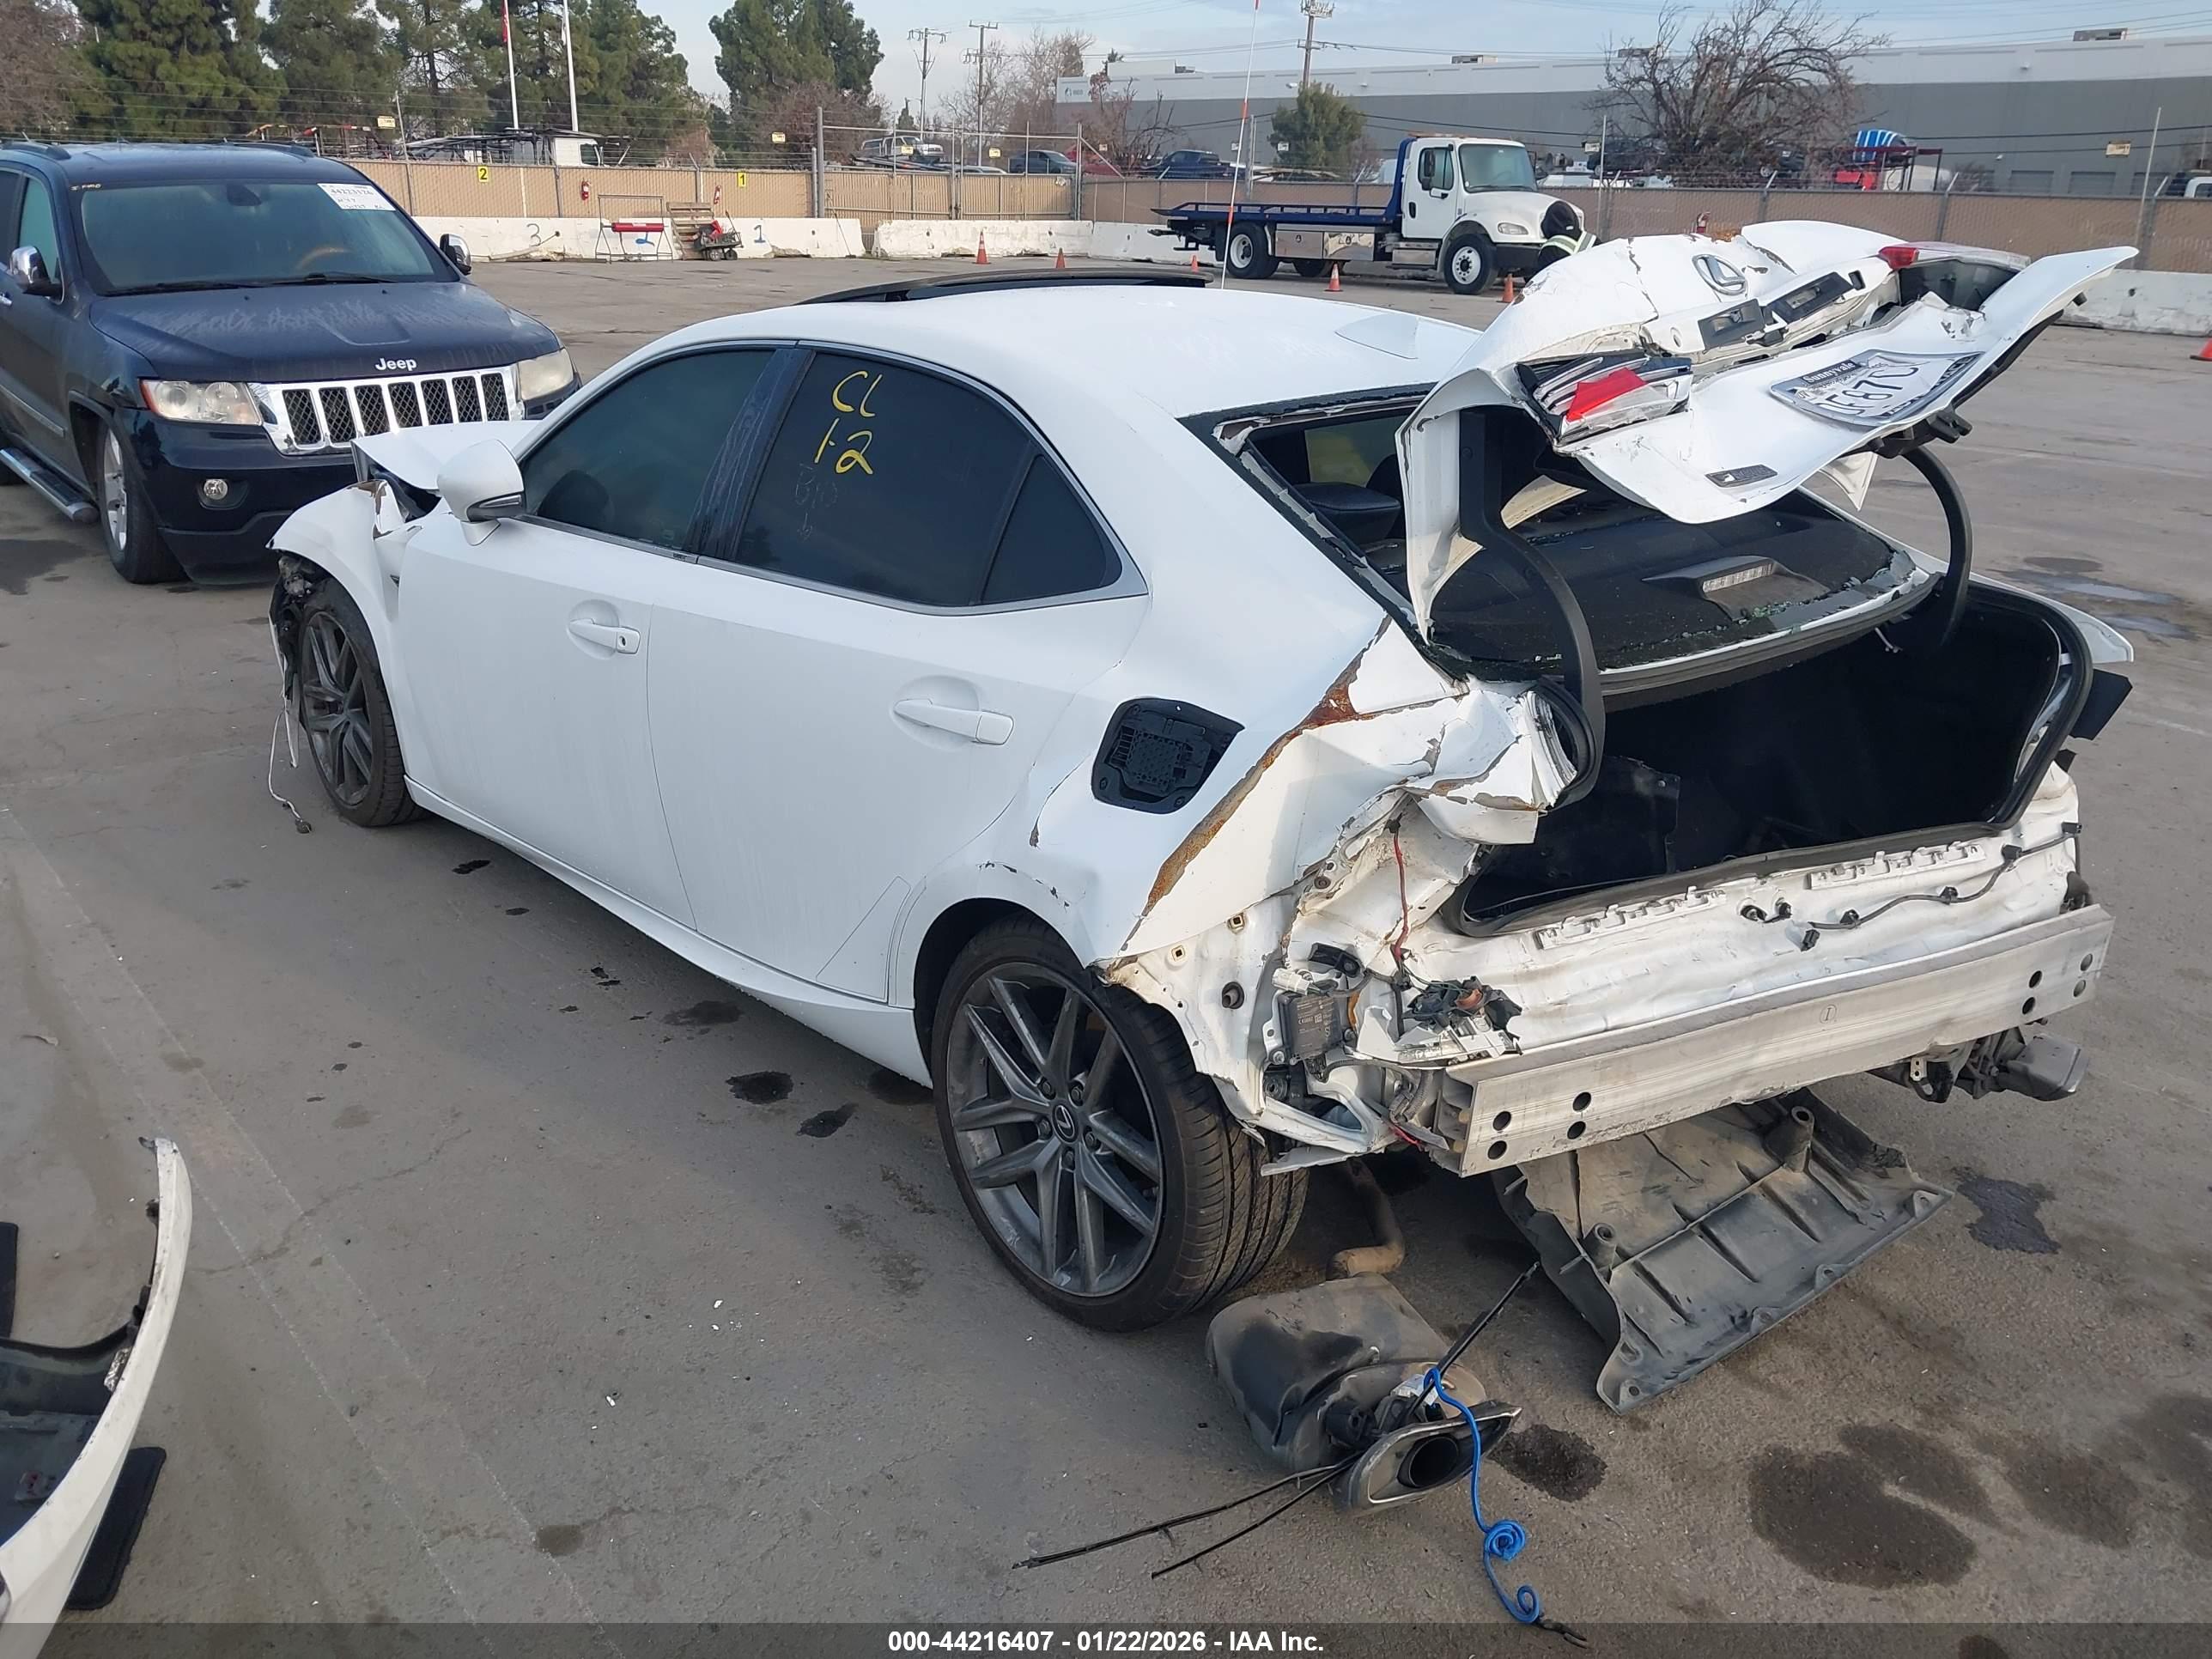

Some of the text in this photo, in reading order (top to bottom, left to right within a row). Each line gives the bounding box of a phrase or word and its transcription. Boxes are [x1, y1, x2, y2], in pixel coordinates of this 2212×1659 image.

[479, 167, 488, 180] 2
[739, 173, 744, 185] 1
[526, 223, 541, 246] 3
[754, 225, 766, 243] 1
[374, 357, 417, 372] Jeep
[1802, 362, 1856, 383] Sunnyvale
